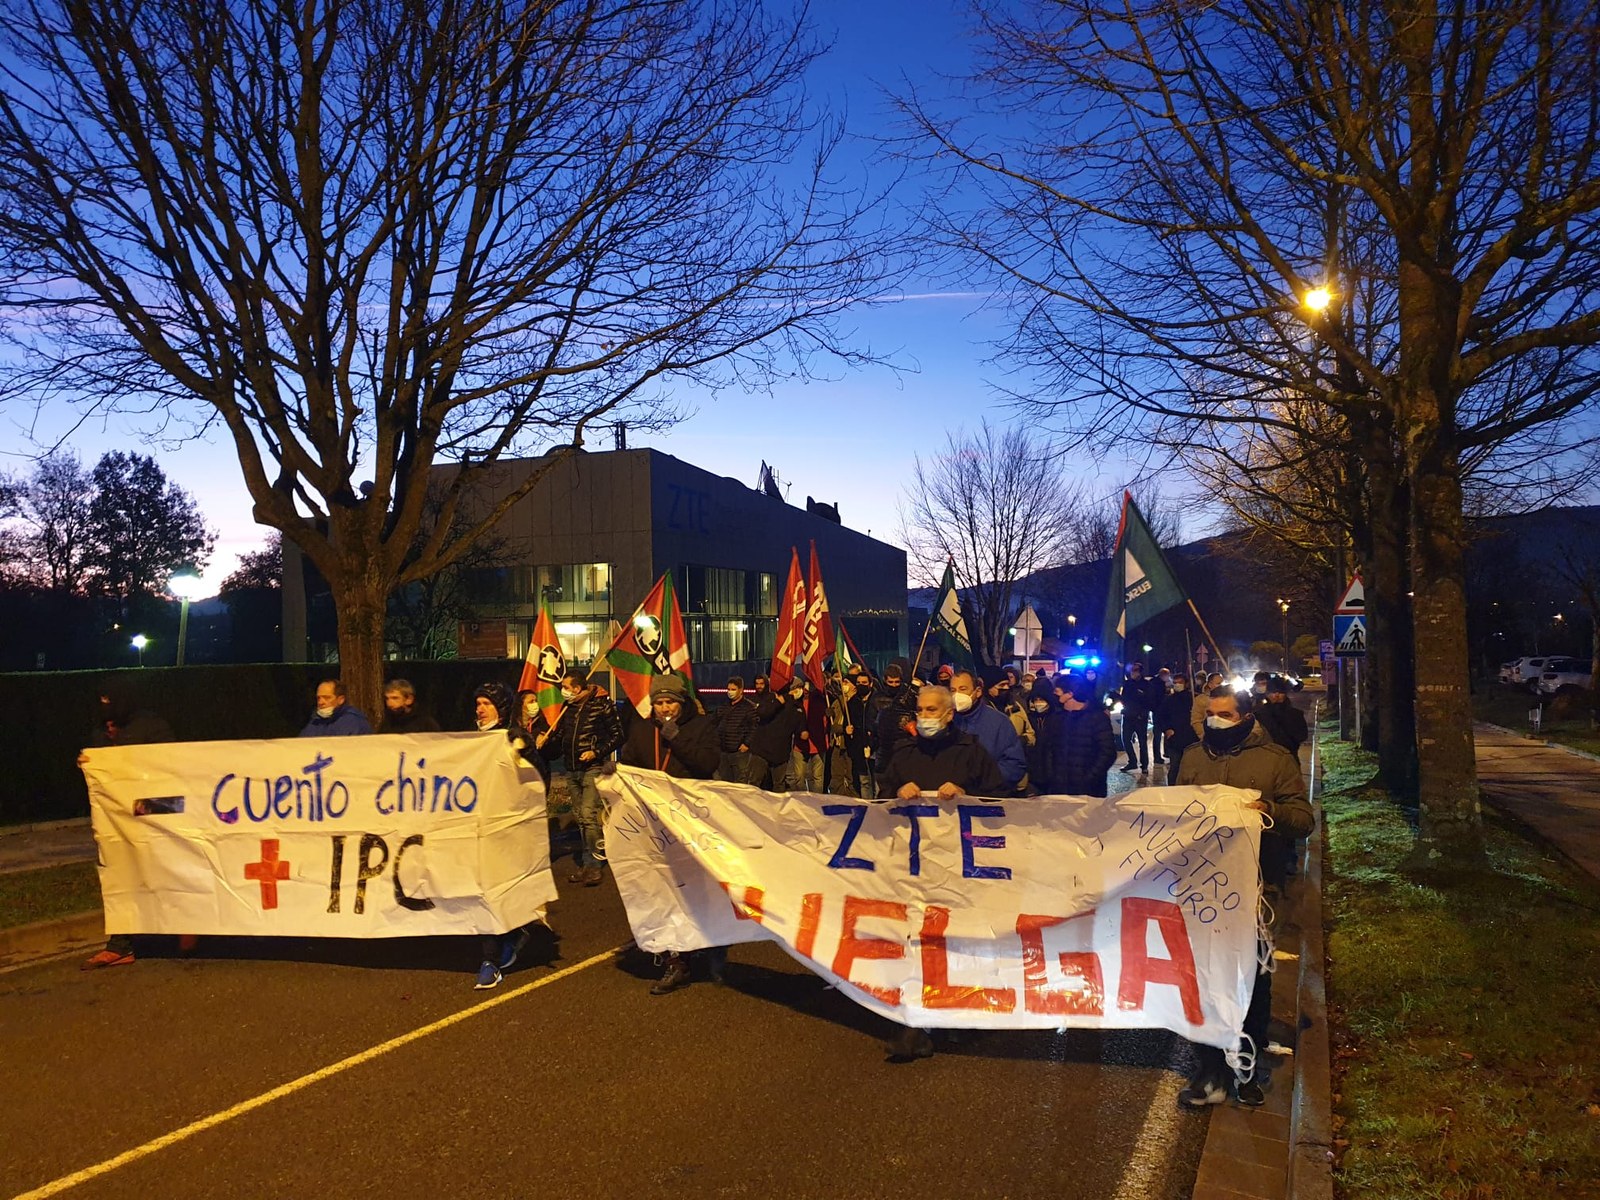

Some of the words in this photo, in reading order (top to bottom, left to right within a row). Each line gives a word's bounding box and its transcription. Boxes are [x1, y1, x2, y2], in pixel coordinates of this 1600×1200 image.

[667, 483, 711, 535] ZTE
[211, 752, 349, 824] cuento
[375, 752, 478, 815] chino
[822, 804, 1012, 880] ZTE
[1129, 810, 1241, 911] NUESTRO
[1176, 799, 1233, 853] POR
[326, 833, 435, 914] IPC
